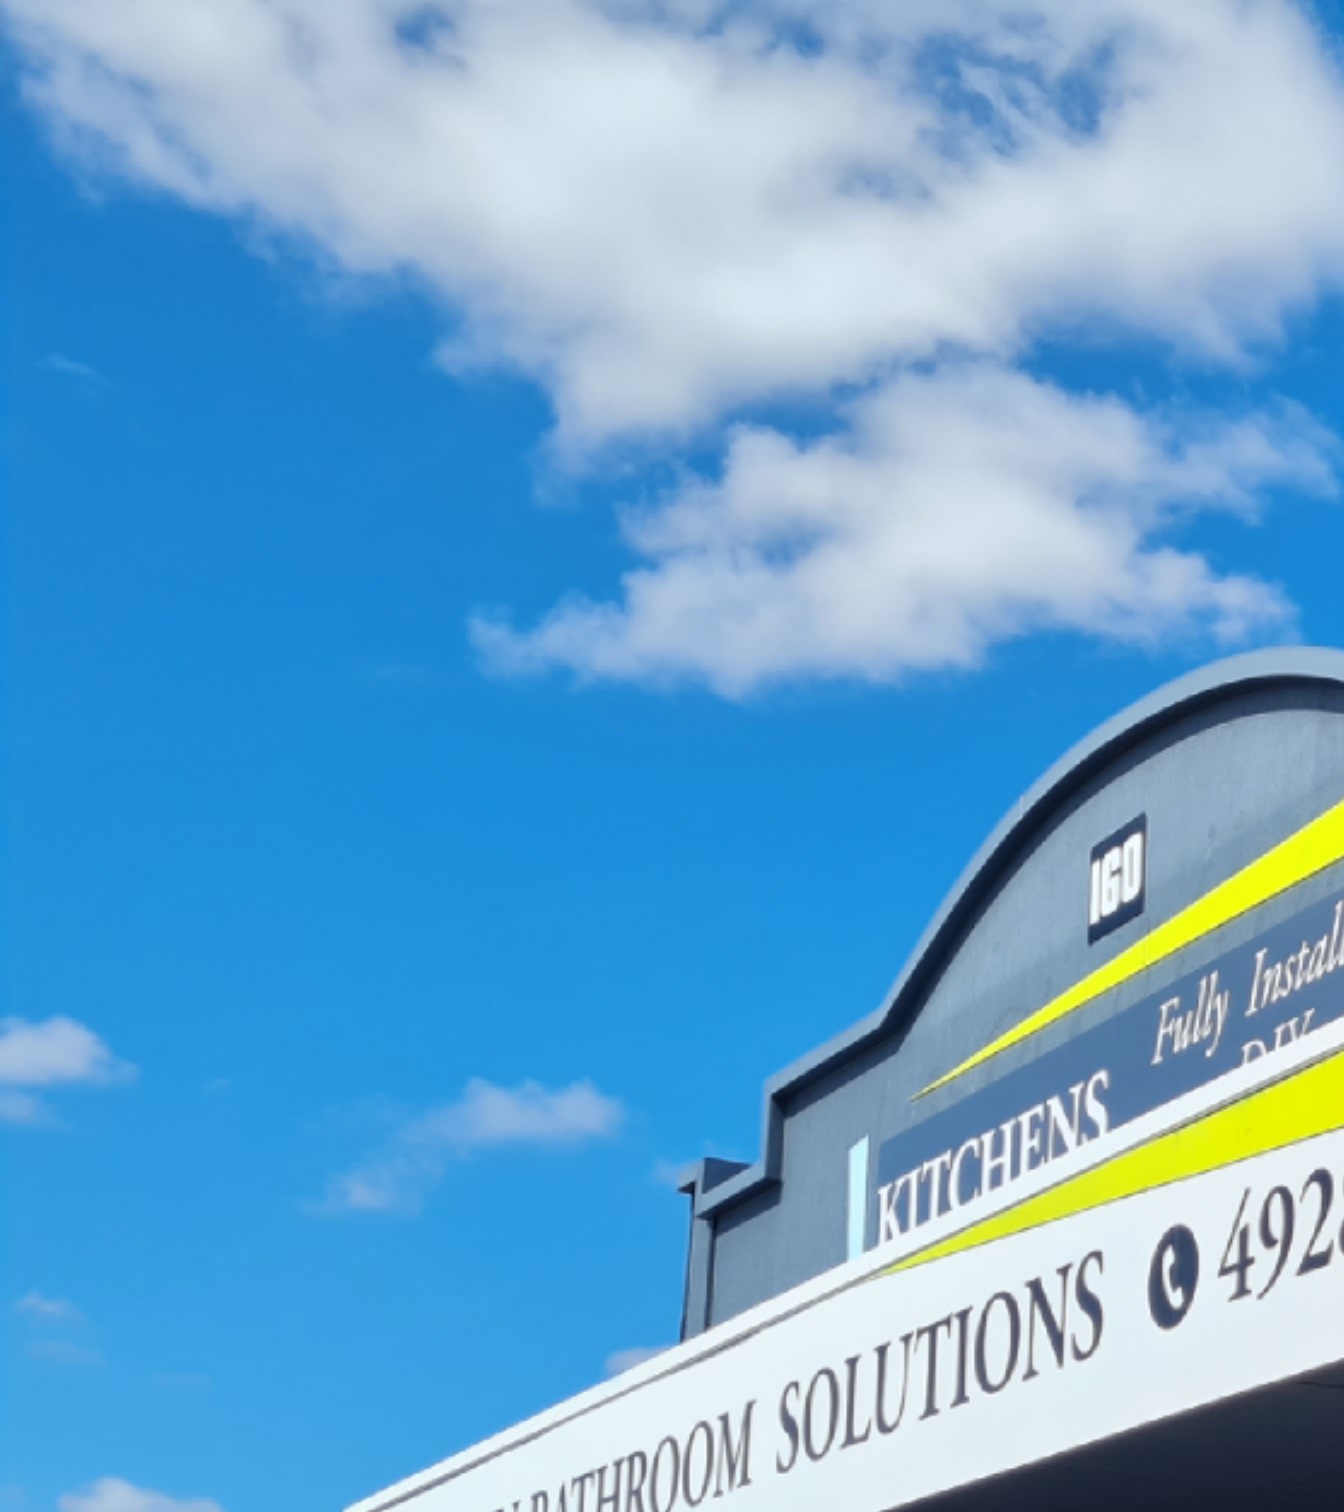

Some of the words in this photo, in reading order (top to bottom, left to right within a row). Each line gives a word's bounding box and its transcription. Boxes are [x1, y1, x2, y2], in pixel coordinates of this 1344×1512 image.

[1089, 832, 1143, 925] 160
[1151, 970, 1229, 1065] Fully
[877, 1069, 1109, 1245] KITCHENS
[775, 1250, 1104, 1474] SOLUTIONS
